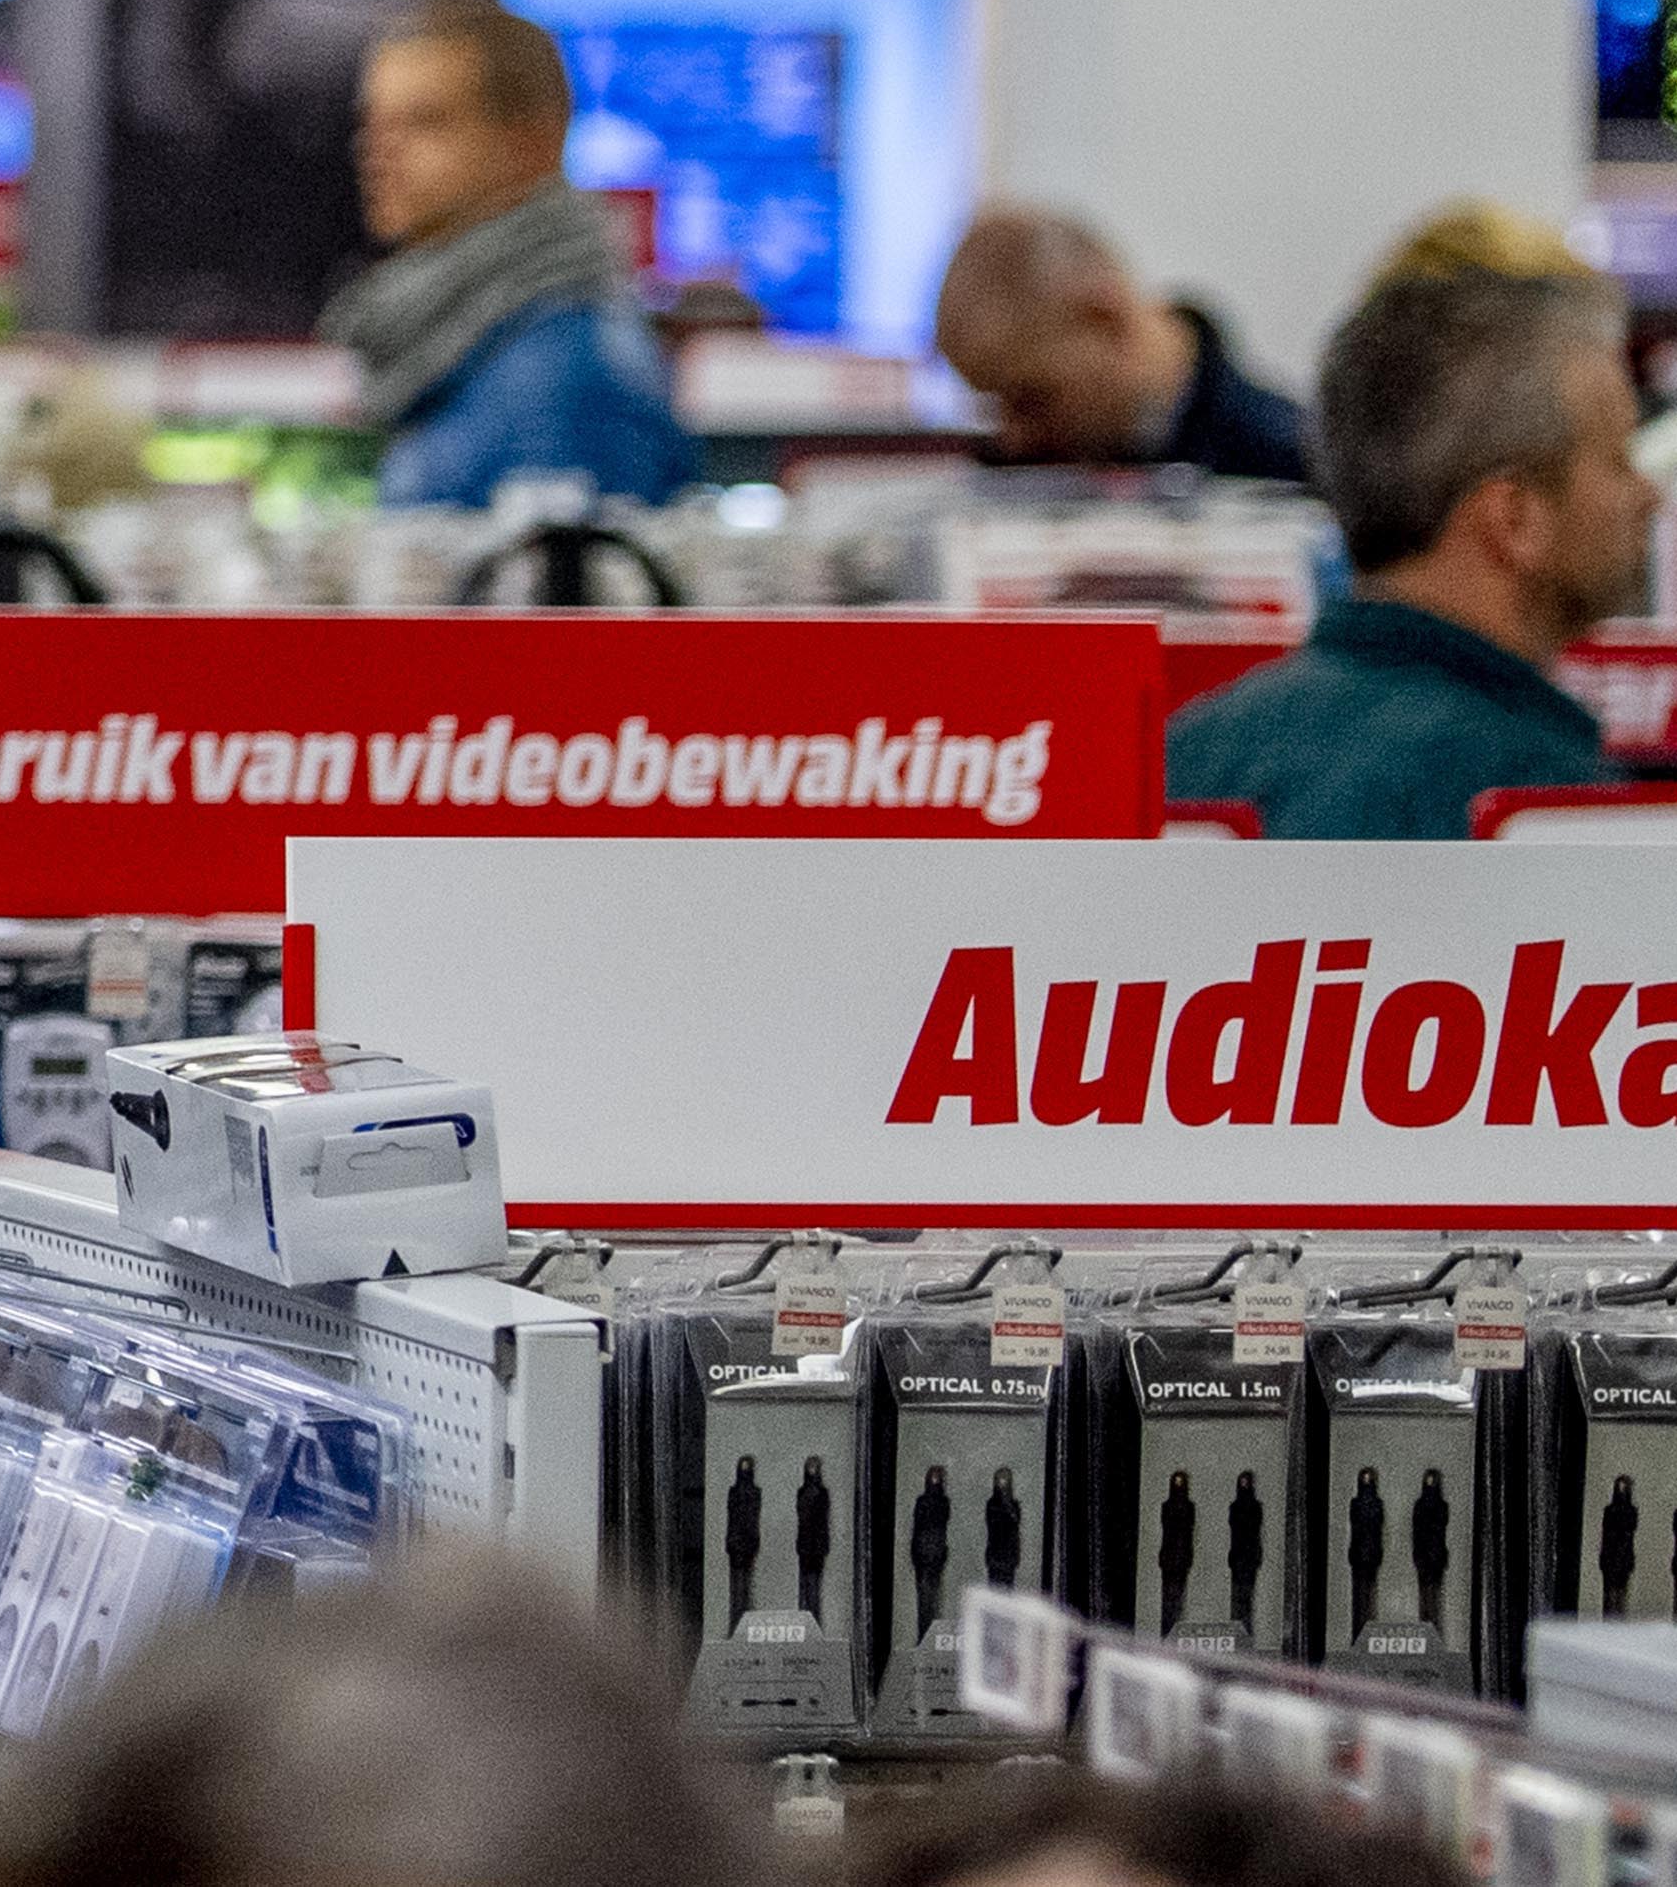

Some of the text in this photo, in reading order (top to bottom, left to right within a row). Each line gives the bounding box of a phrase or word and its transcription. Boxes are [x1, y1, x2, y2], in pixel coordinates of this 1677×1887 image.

[188, 725, 356, 807] van
[367, 714, 1053, 826] videobewaking
[1003, 1296, 1053, 1309] VIVANCO
[1244, 1295, 1293, 1307] VIVANCO
[1465, 1299, 1515, 1311] VIVANCO
[709, 1364, 788, 1381] OPTICAL
[900, 1376, 1045, 1397] OPTICAL 0.75m
[1148, 1381, 1281, 1398] OPTICAL 1.5m
[1593, 1388, 1676, 1404] OPTICAL
